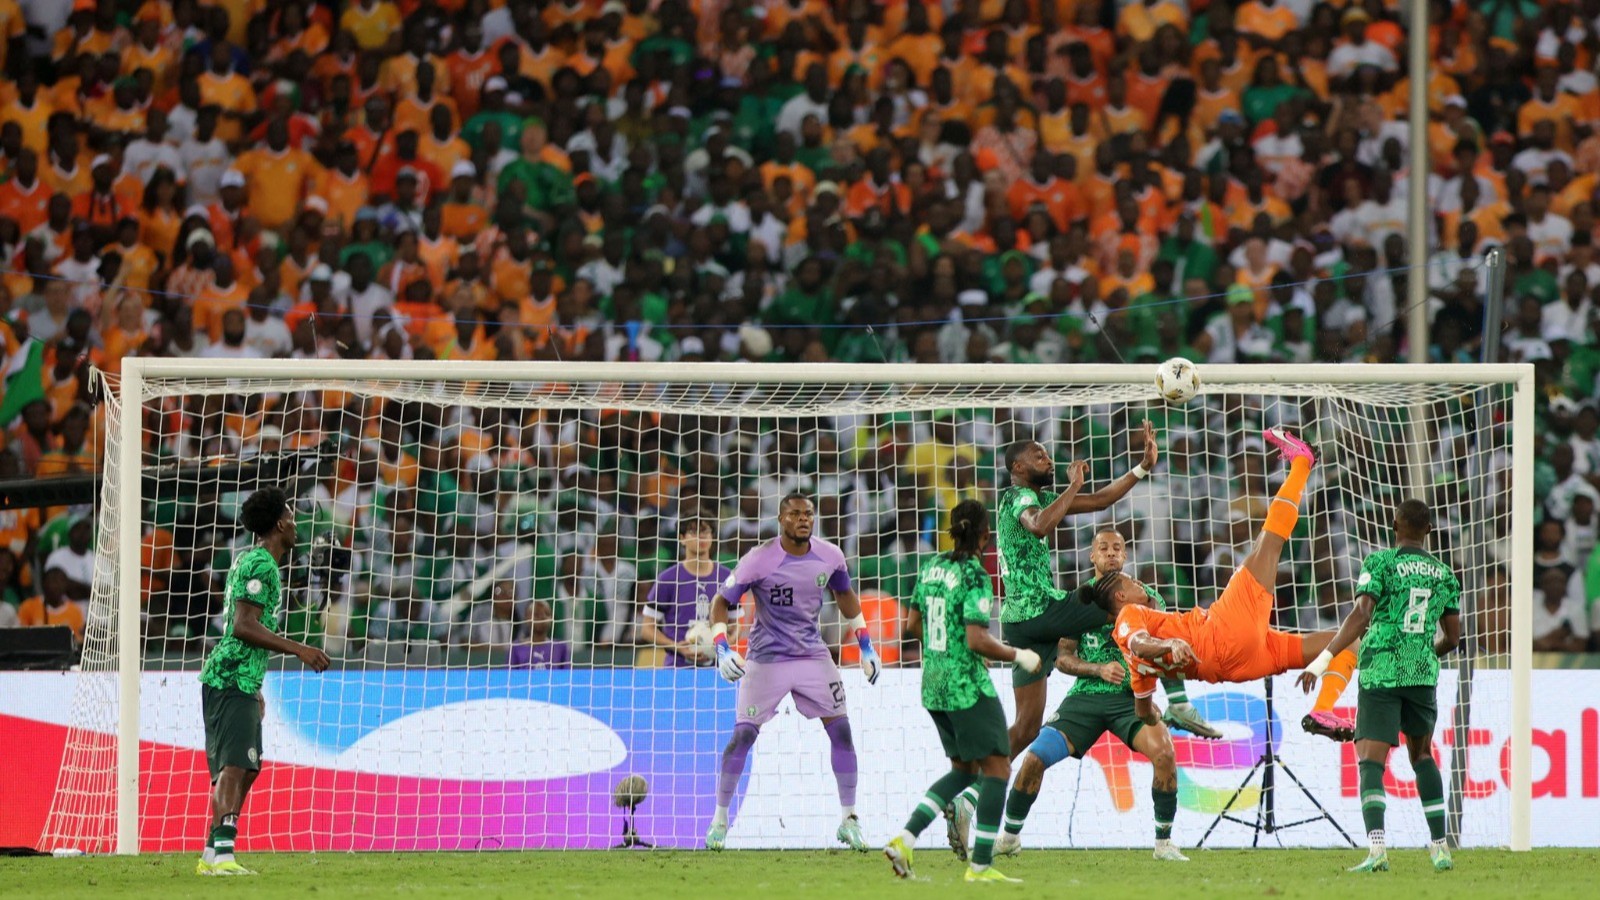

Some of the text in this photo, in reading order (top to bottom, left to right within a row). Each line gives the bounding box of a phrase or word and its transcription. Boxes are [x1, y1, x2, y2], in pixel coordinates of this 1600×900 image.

[1396, 561, 1443, 580] ONYEKA
[769, 587, 793, 607] 23
[1402, 587, 1432, 634] 8
[925, 596, 947, 652] 18
